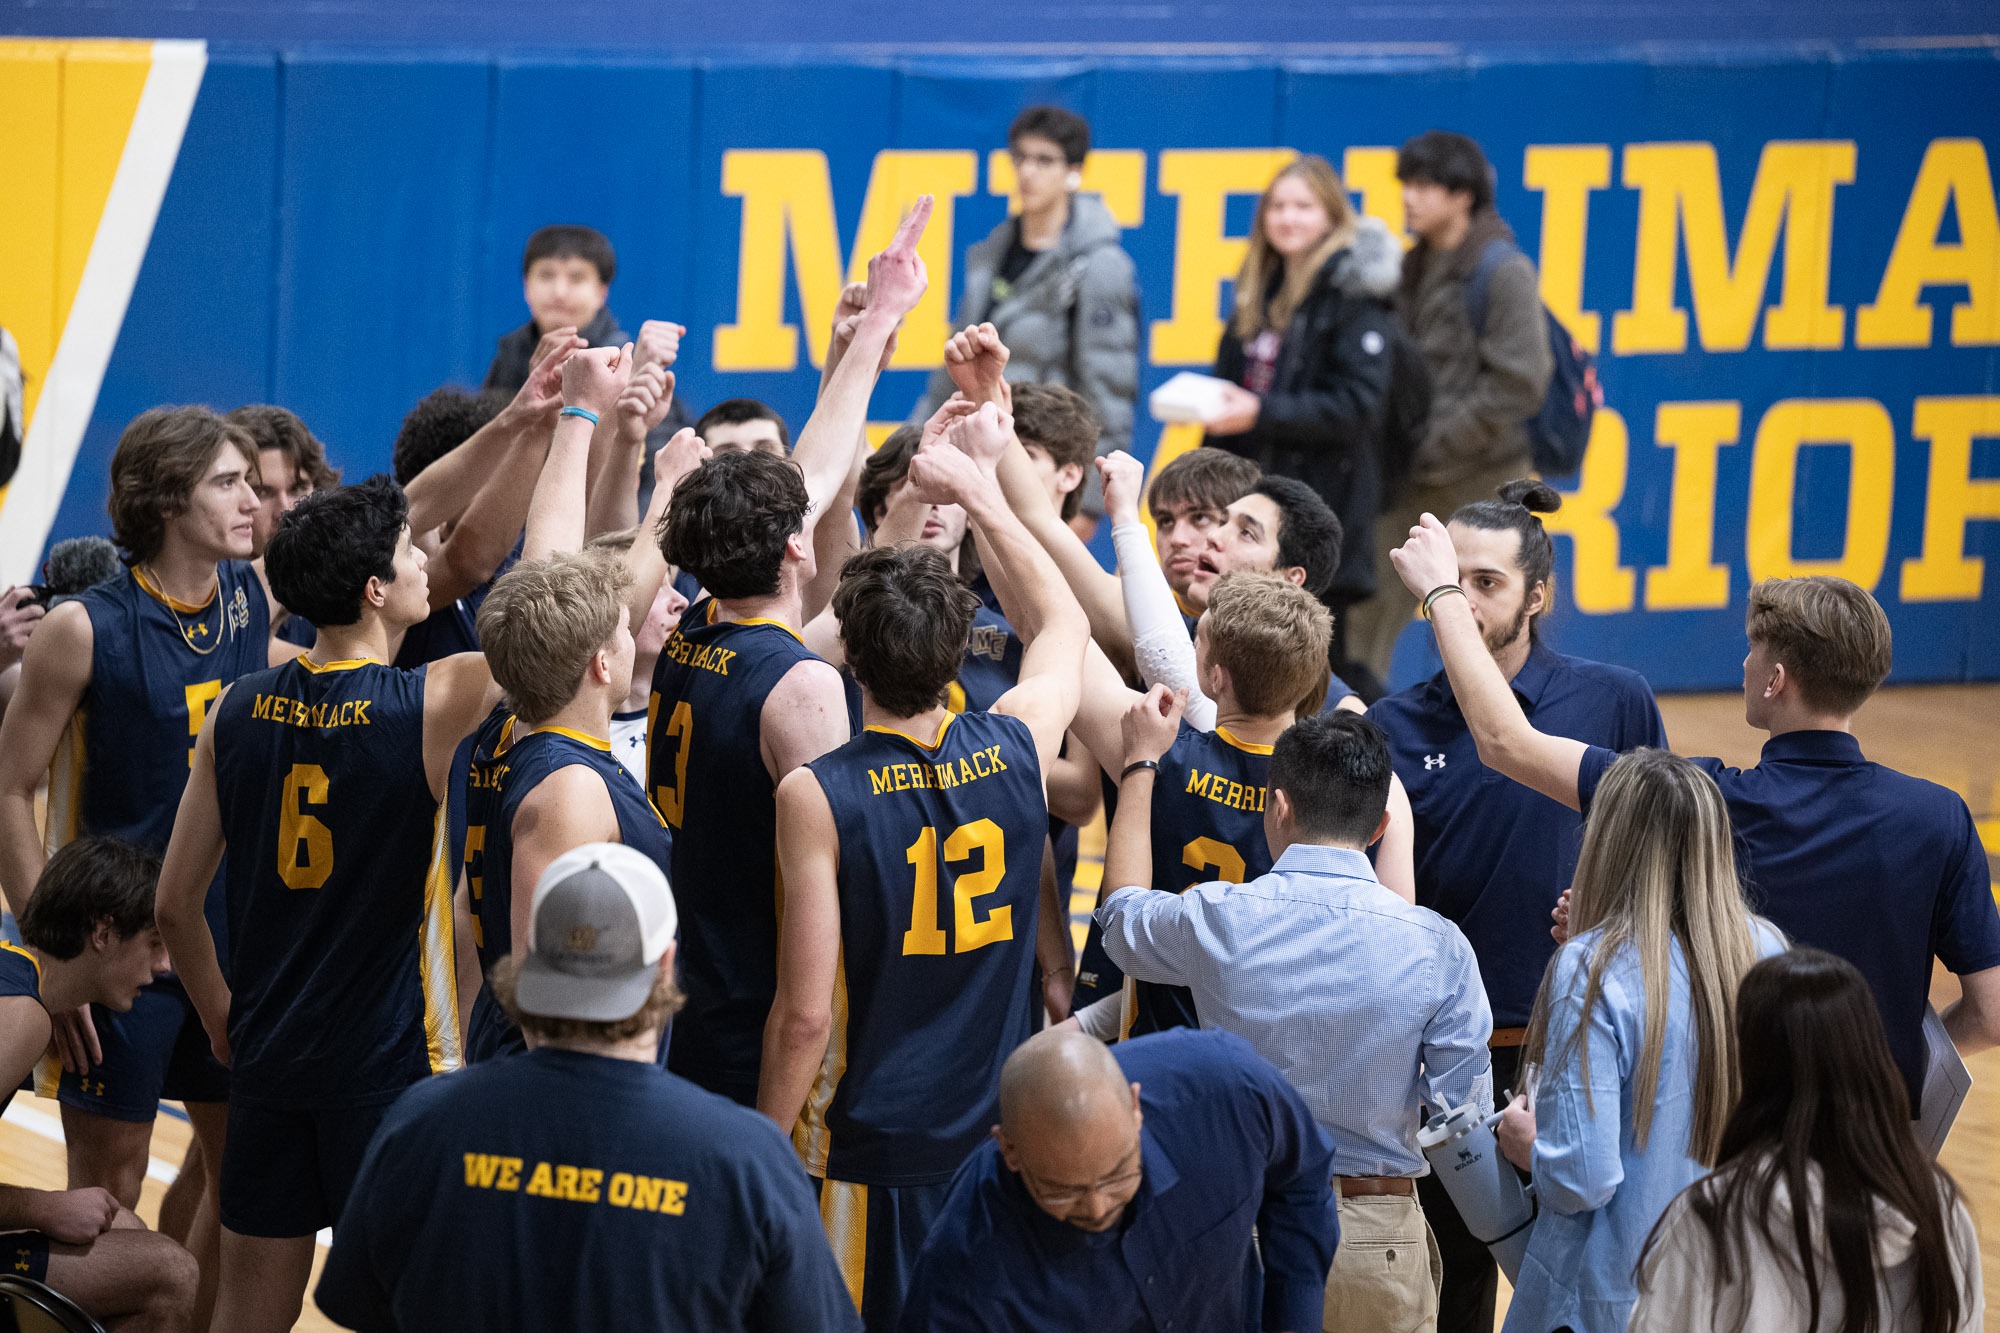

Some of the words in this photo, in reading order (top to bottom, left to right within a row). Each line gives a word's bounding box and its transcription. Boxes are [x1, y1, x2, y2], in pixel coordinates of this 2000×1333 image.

[712, 137, 2000, 372] MRIMA
[972, 624, 1008, 661] MC
[867, 745, 1007, 795] MERRIMACK
[1185, 768, 1267, 812] MERRI
[277, 764, 334, 889] 6
[902, 817, 1014, 956] 12
[463, 1152, 524, 1191] WE
[525, 1161, 604, 1203] ARE
[608, 1172, 689, 1216] ONE
[1454, 1152, 1482, 1171] STANLEY
